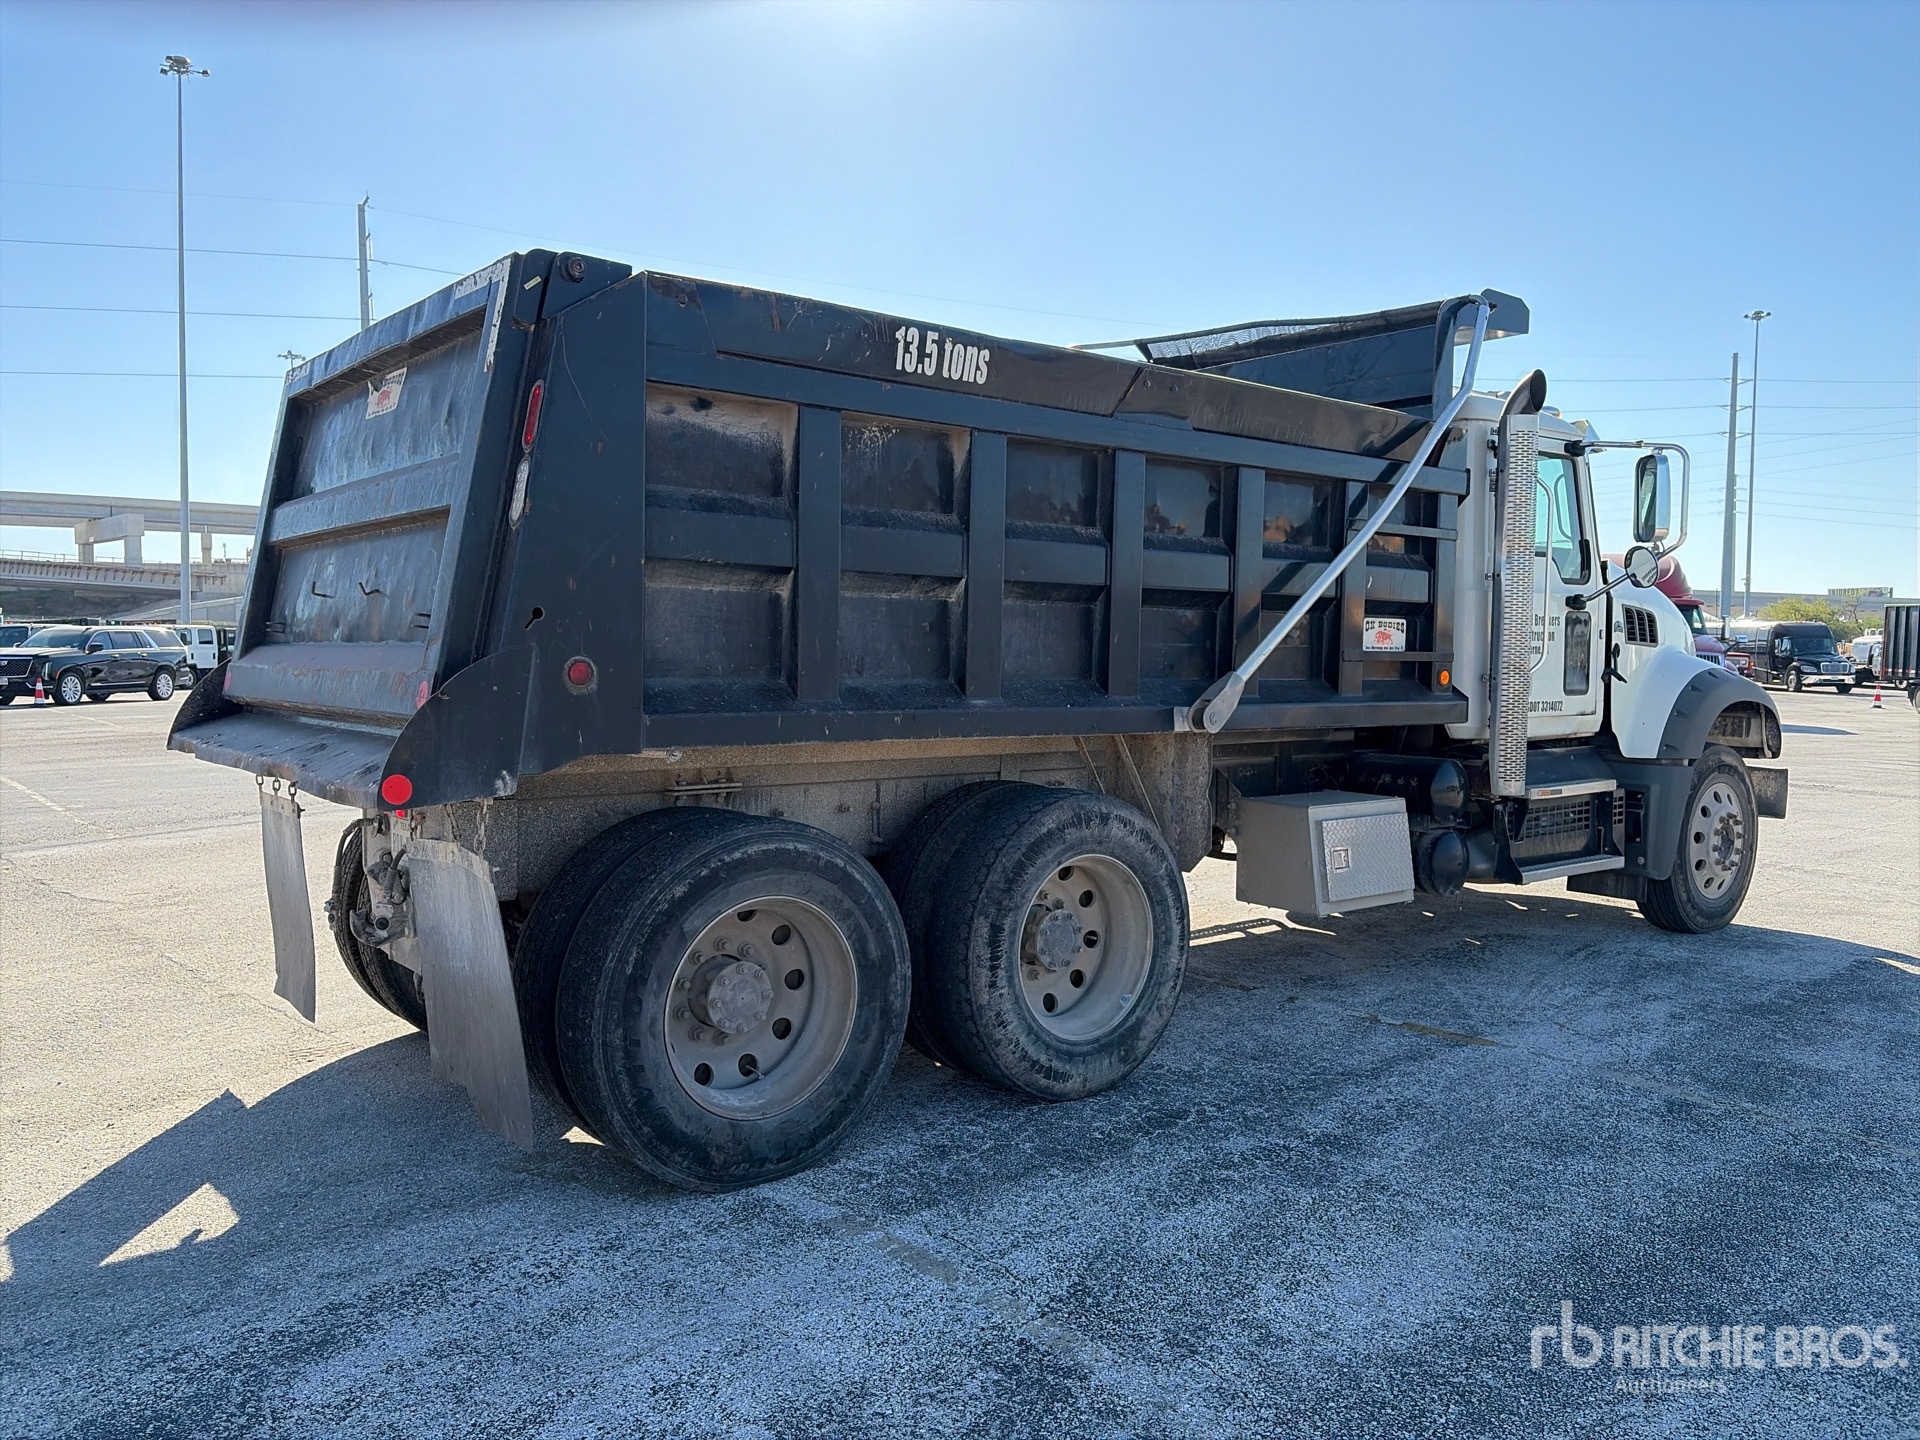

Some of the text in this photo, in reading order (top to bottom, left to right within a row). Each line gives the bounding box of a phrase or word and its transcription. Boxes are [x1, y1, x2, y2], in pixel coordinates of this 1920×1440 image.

[895, 326, 990, 384] 13.5 tons
[1378, 621, 1404, 634] BODIES
[1541, 700, 1564, 712] 3314072
